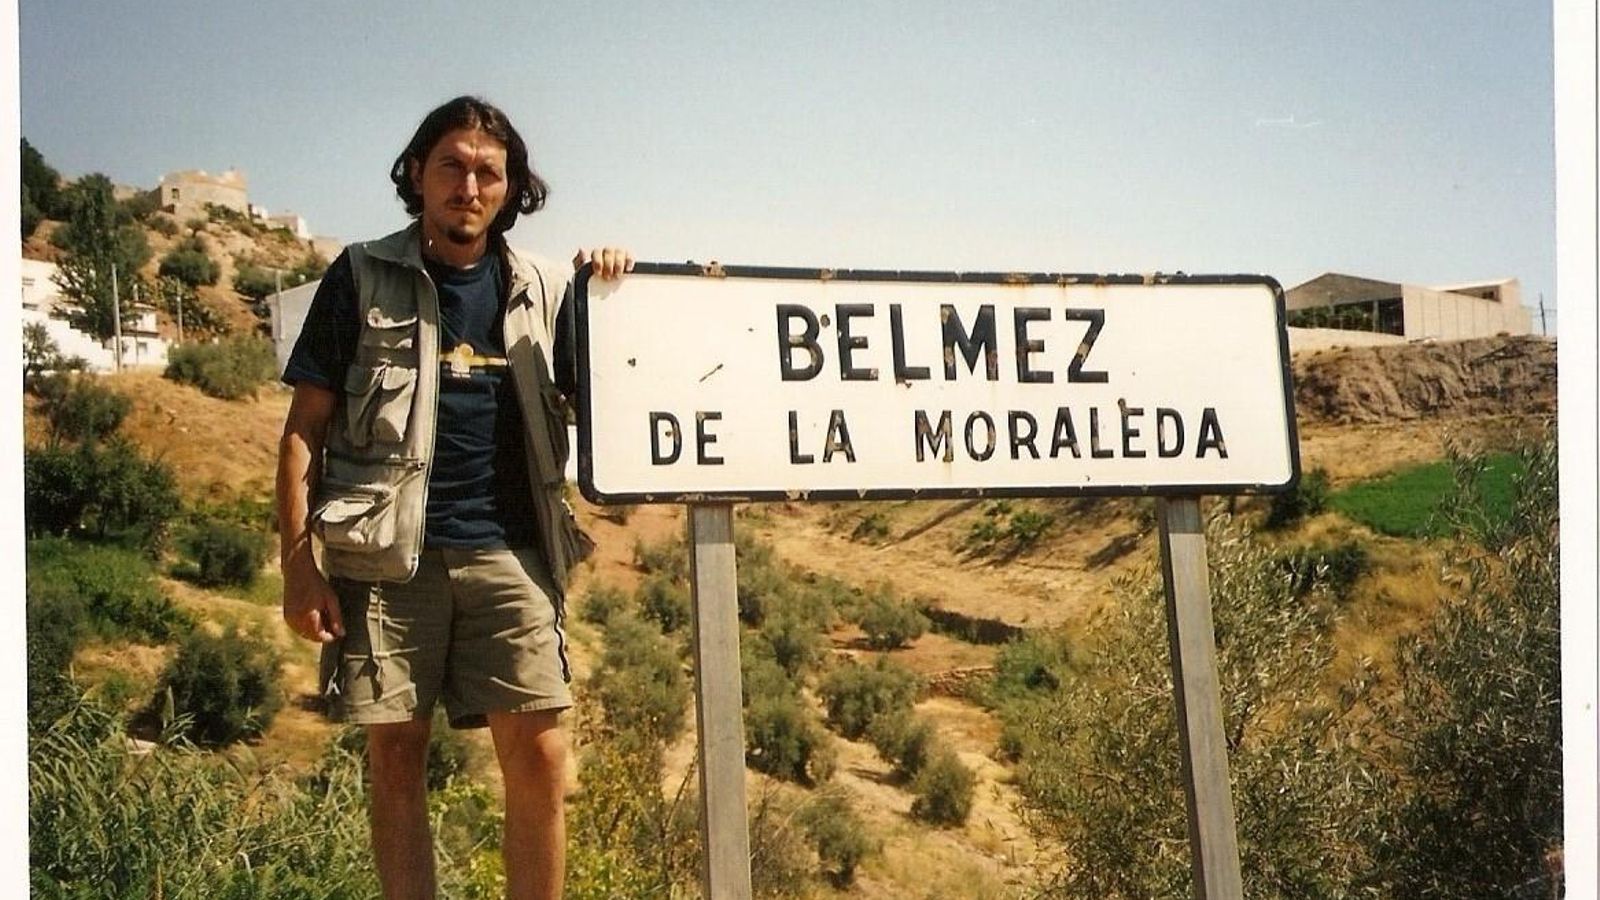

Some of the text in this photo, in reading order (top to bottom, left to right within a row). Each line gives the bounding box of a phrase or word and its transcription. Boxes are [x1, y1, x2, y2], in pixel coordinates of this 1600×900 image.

[776, 303, 1109, 384] BELMEZ
[649, 406, 1229, 466] DE LA MORALEDA
